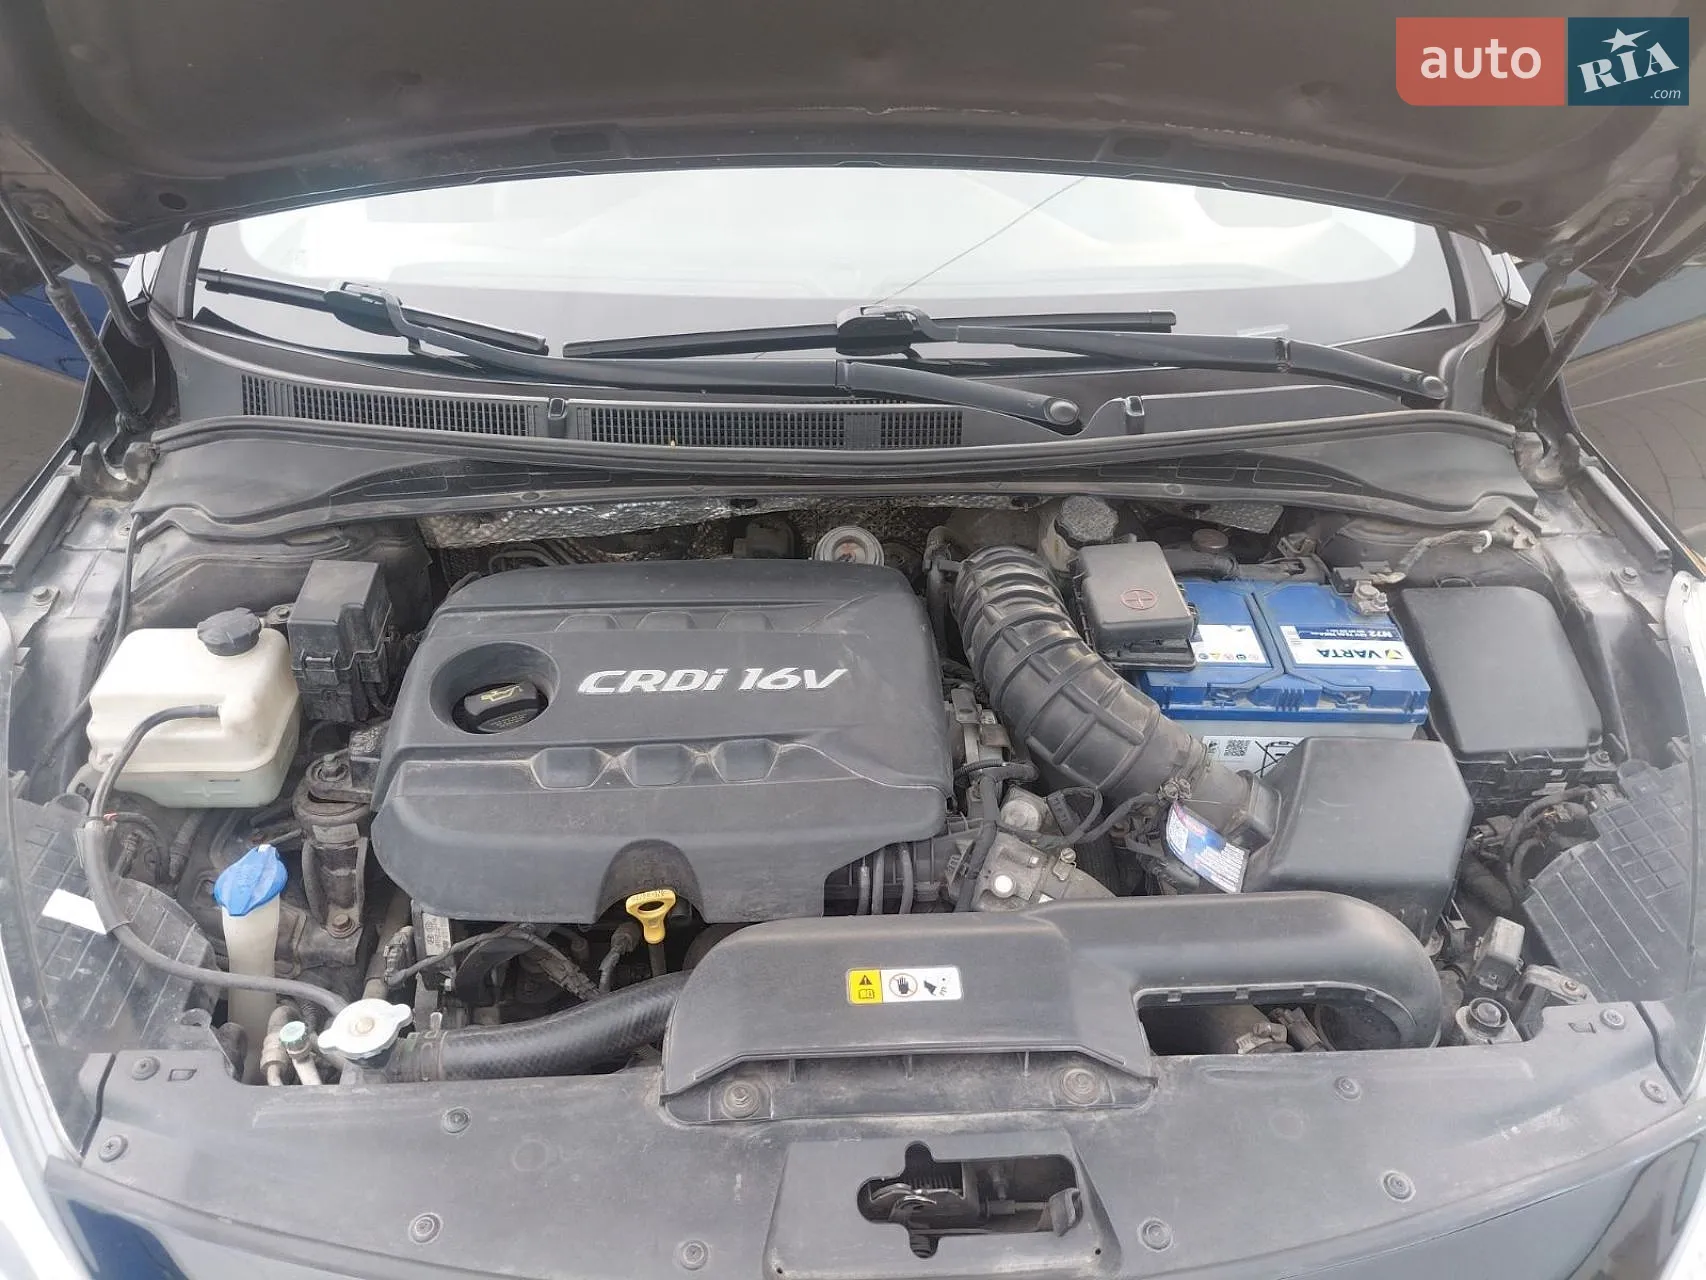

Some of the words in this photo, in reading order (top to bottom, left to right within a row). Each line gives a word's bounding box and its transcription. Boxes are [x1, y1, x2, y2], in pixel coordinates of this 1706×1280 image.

[1317, 649, 1382, 659] VARTA
[577, 668, 730, 693] CRDi
[739, 667, 848, 690] 16V
